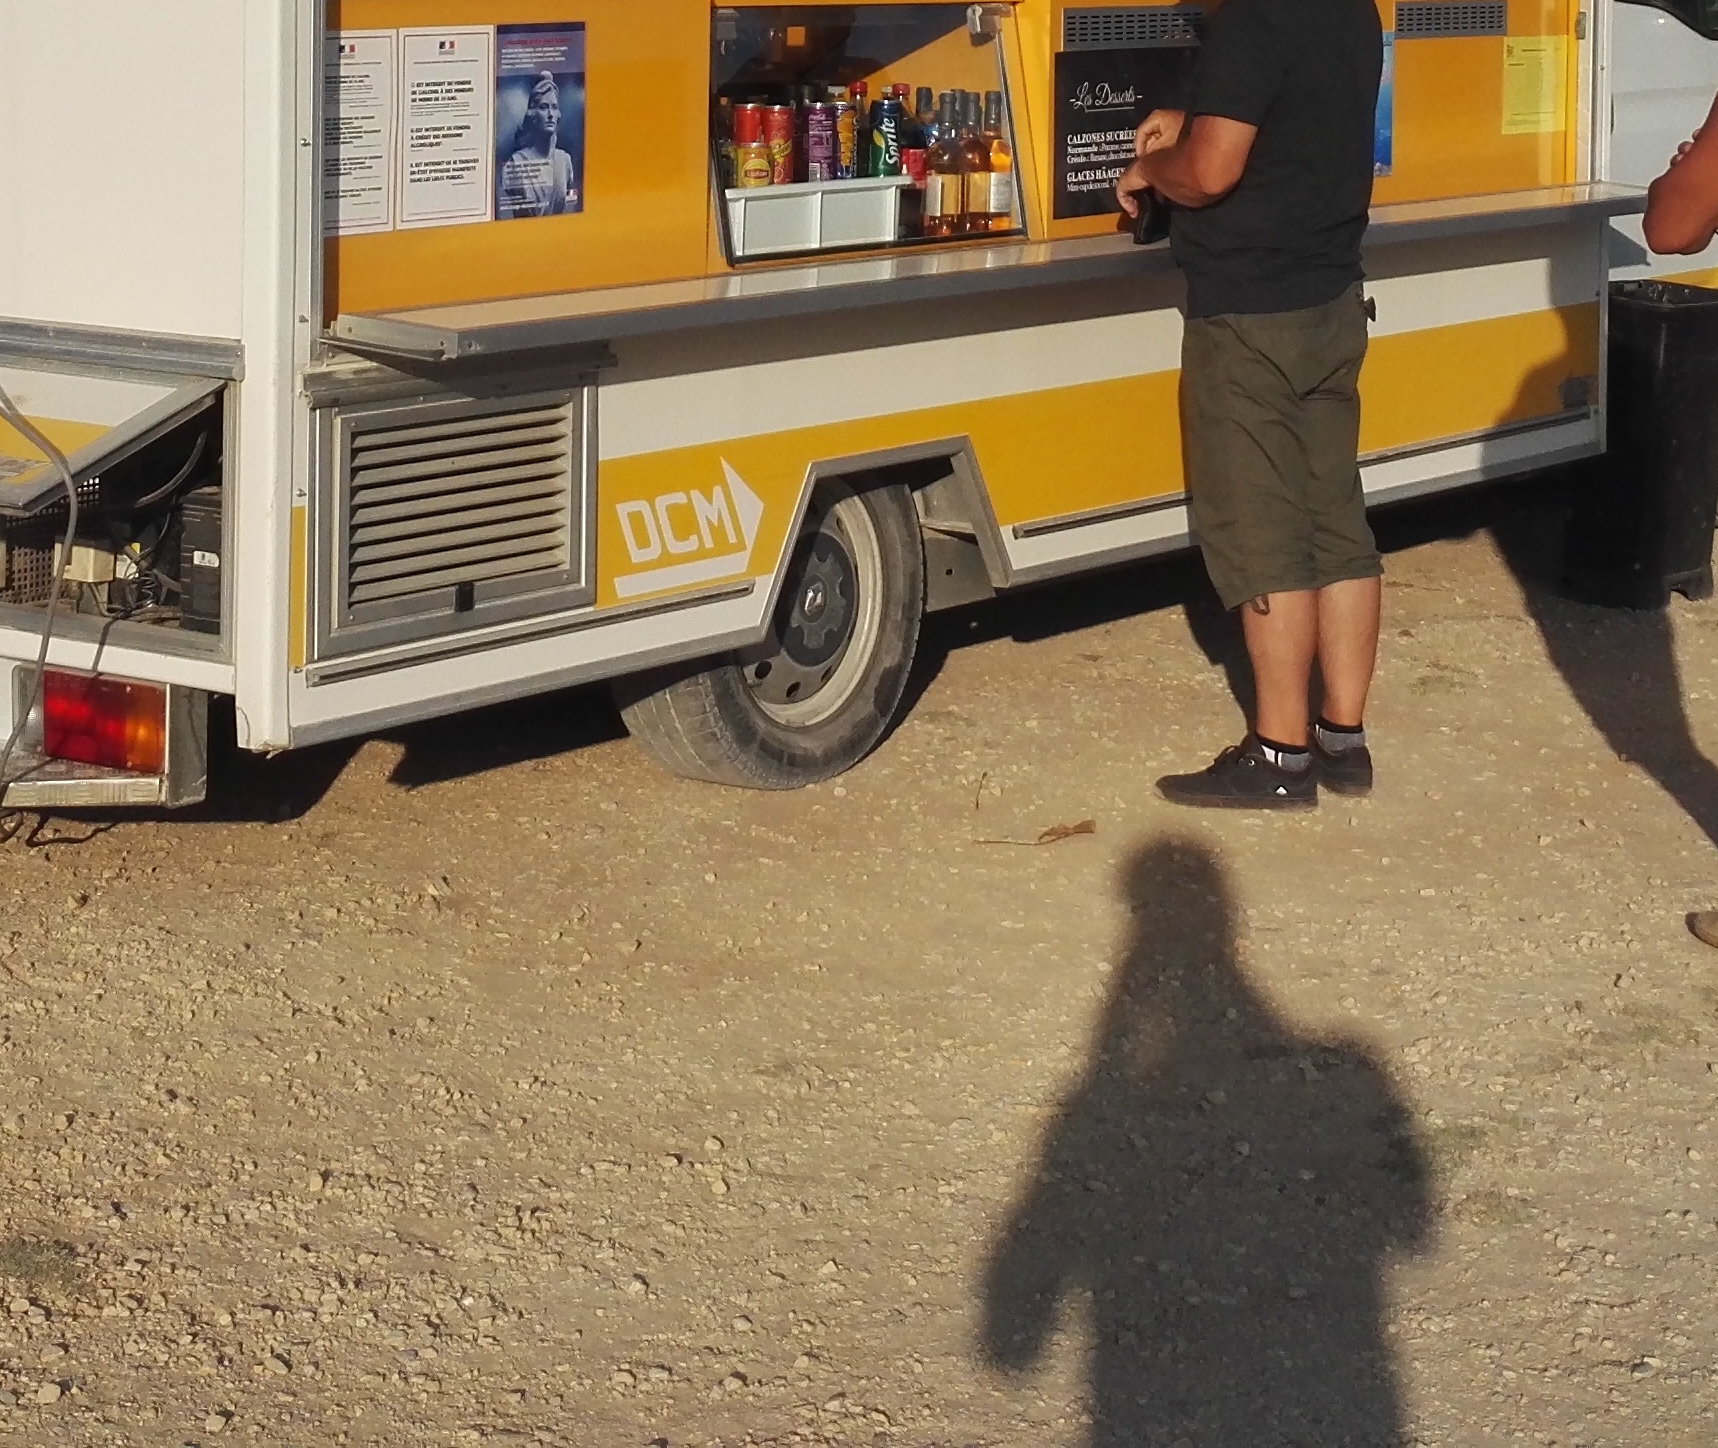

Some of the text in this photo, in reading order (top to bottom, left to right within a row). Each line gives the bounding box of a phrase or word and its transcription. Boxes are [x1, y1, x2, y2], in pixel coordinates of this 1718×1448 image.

[1073, 81, 1135, 110] Les Desserts
[879, 117, 901, 167] Sprite
[1067, 132, 1105, 144] CALZONES
[746, 170, 768, 178] Lipton
[1067, 170, 1094, 182] GLACES
[615, 485, 738, 563] DCM
